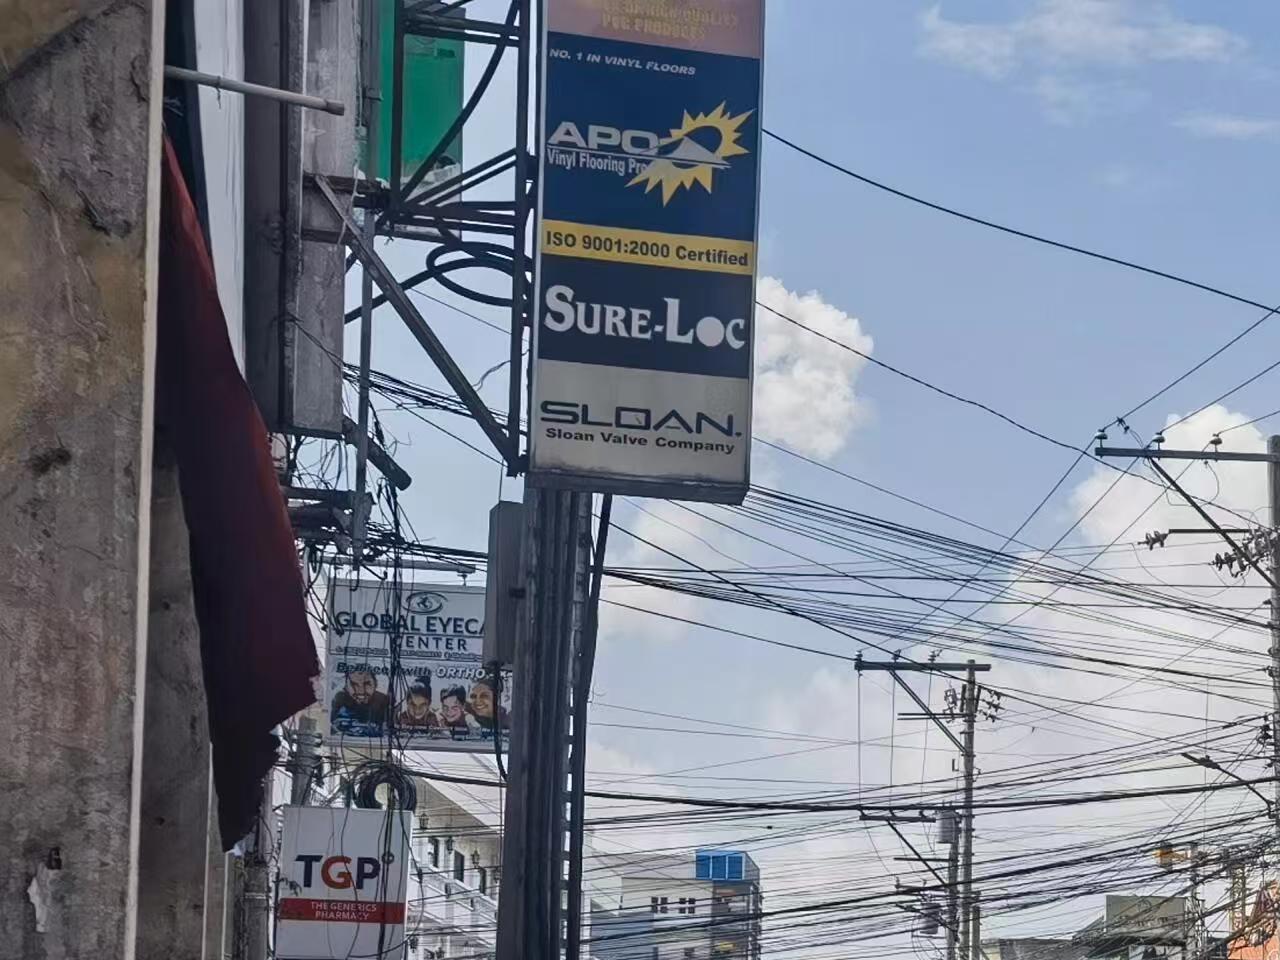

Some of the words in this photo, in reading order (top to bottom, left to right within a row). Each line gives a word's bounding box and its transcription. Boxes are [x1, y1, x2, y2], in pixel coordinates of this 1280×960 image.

[550, 49, 571, 60] NO.
[576, 52, 583, 61] 1
[586, 54, 601, 63] IN
[604, 56, 642, 69] VINYL
[646, 61, 696, 76] FLOORS
[547, 121, 661, 156] APO
[547, 149, 577, 170] Vinyl
[579, 152, 625, 176] Flooring
[546, 230, 577, 247] ISO
[583, 234, 670, 257] 9001:2000
[675, 246, 749, 267] Certified
[545, 428, 594, 442] Sloan
[600, 431, 648, 446] Valve
[655, 436, 735, 455] Company
[336, 611, 421, 632] GLOBAL
[295, 854, 381, 890] TGP
[311, 901, 329, 910] THE
